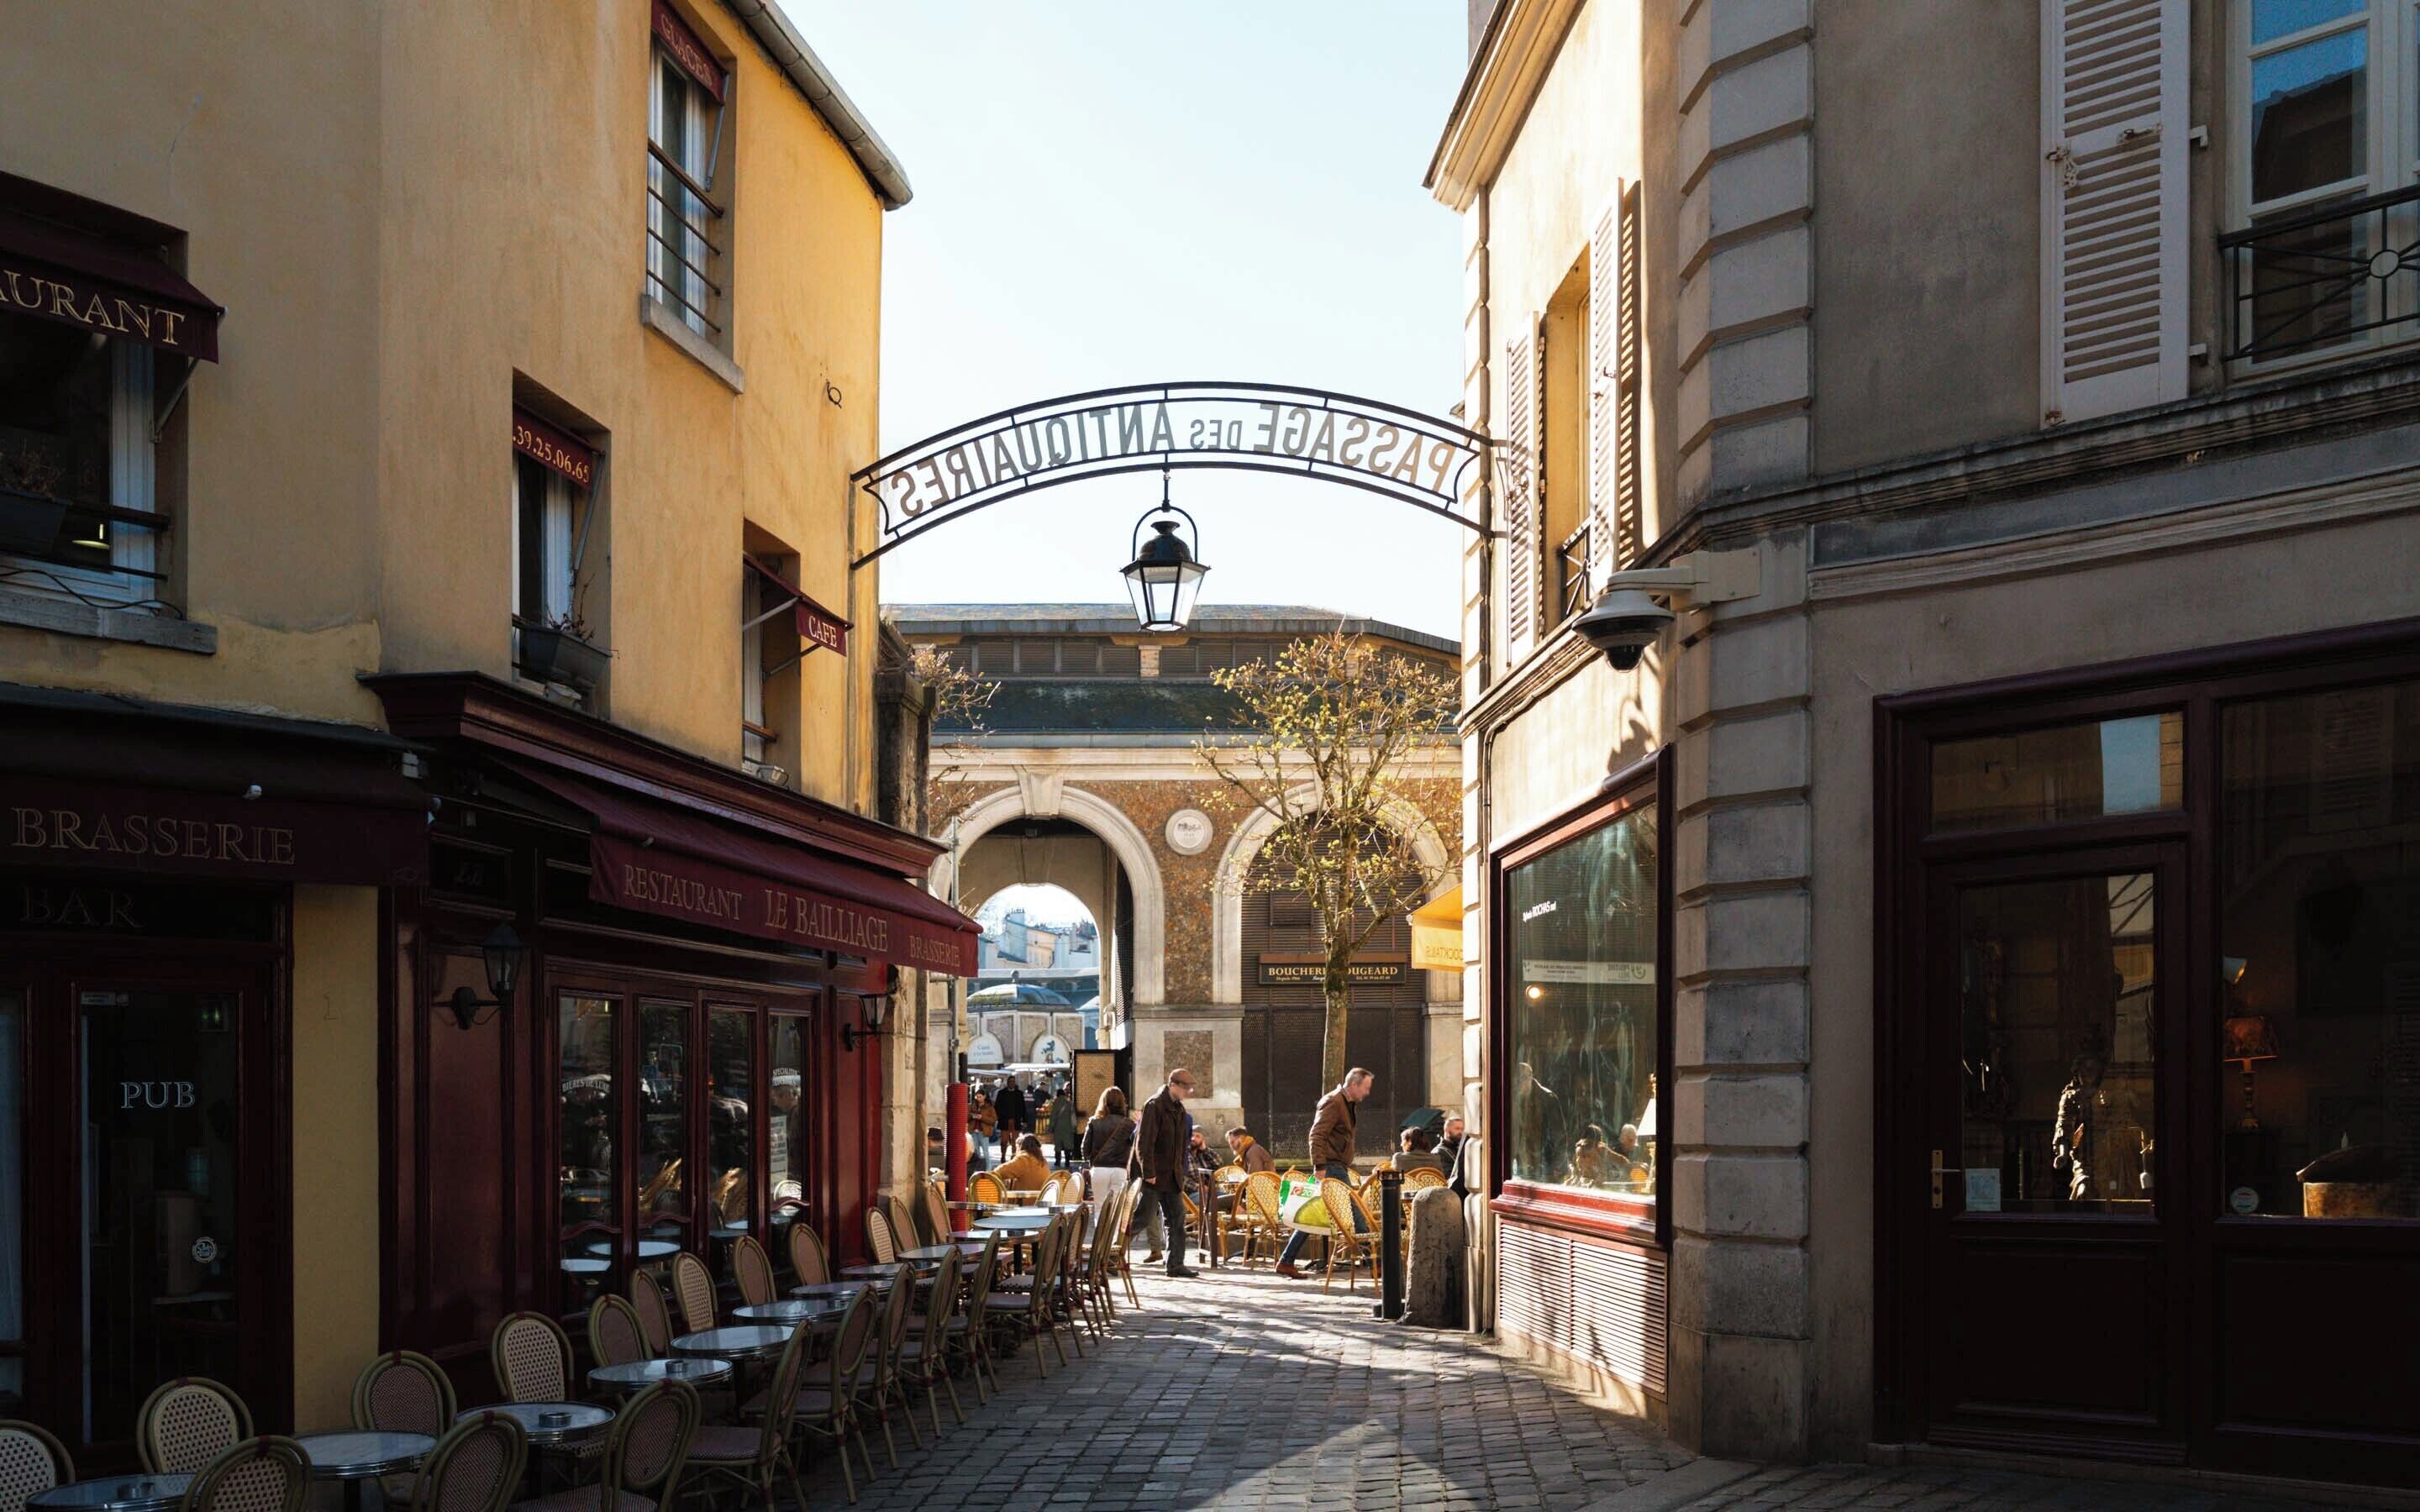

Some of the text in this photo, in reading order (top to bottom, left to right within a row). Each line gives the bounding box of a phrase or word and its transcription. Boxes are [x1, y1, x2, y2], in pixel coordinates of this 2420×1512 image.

[660, 13, 713, 87] GLACES
[808, 615, 837, 648] CAFE
[8, 806, 296, 866] BRASSERIE
[21, 886, 145, 928] BAR
[624, 864, 960, 968] RESTAURANT LE BAILLIAGE BRASSERIE
[1268, 967, 1326, 976] BOUCHERI
[120, 1081, 196, 1110] PUB
